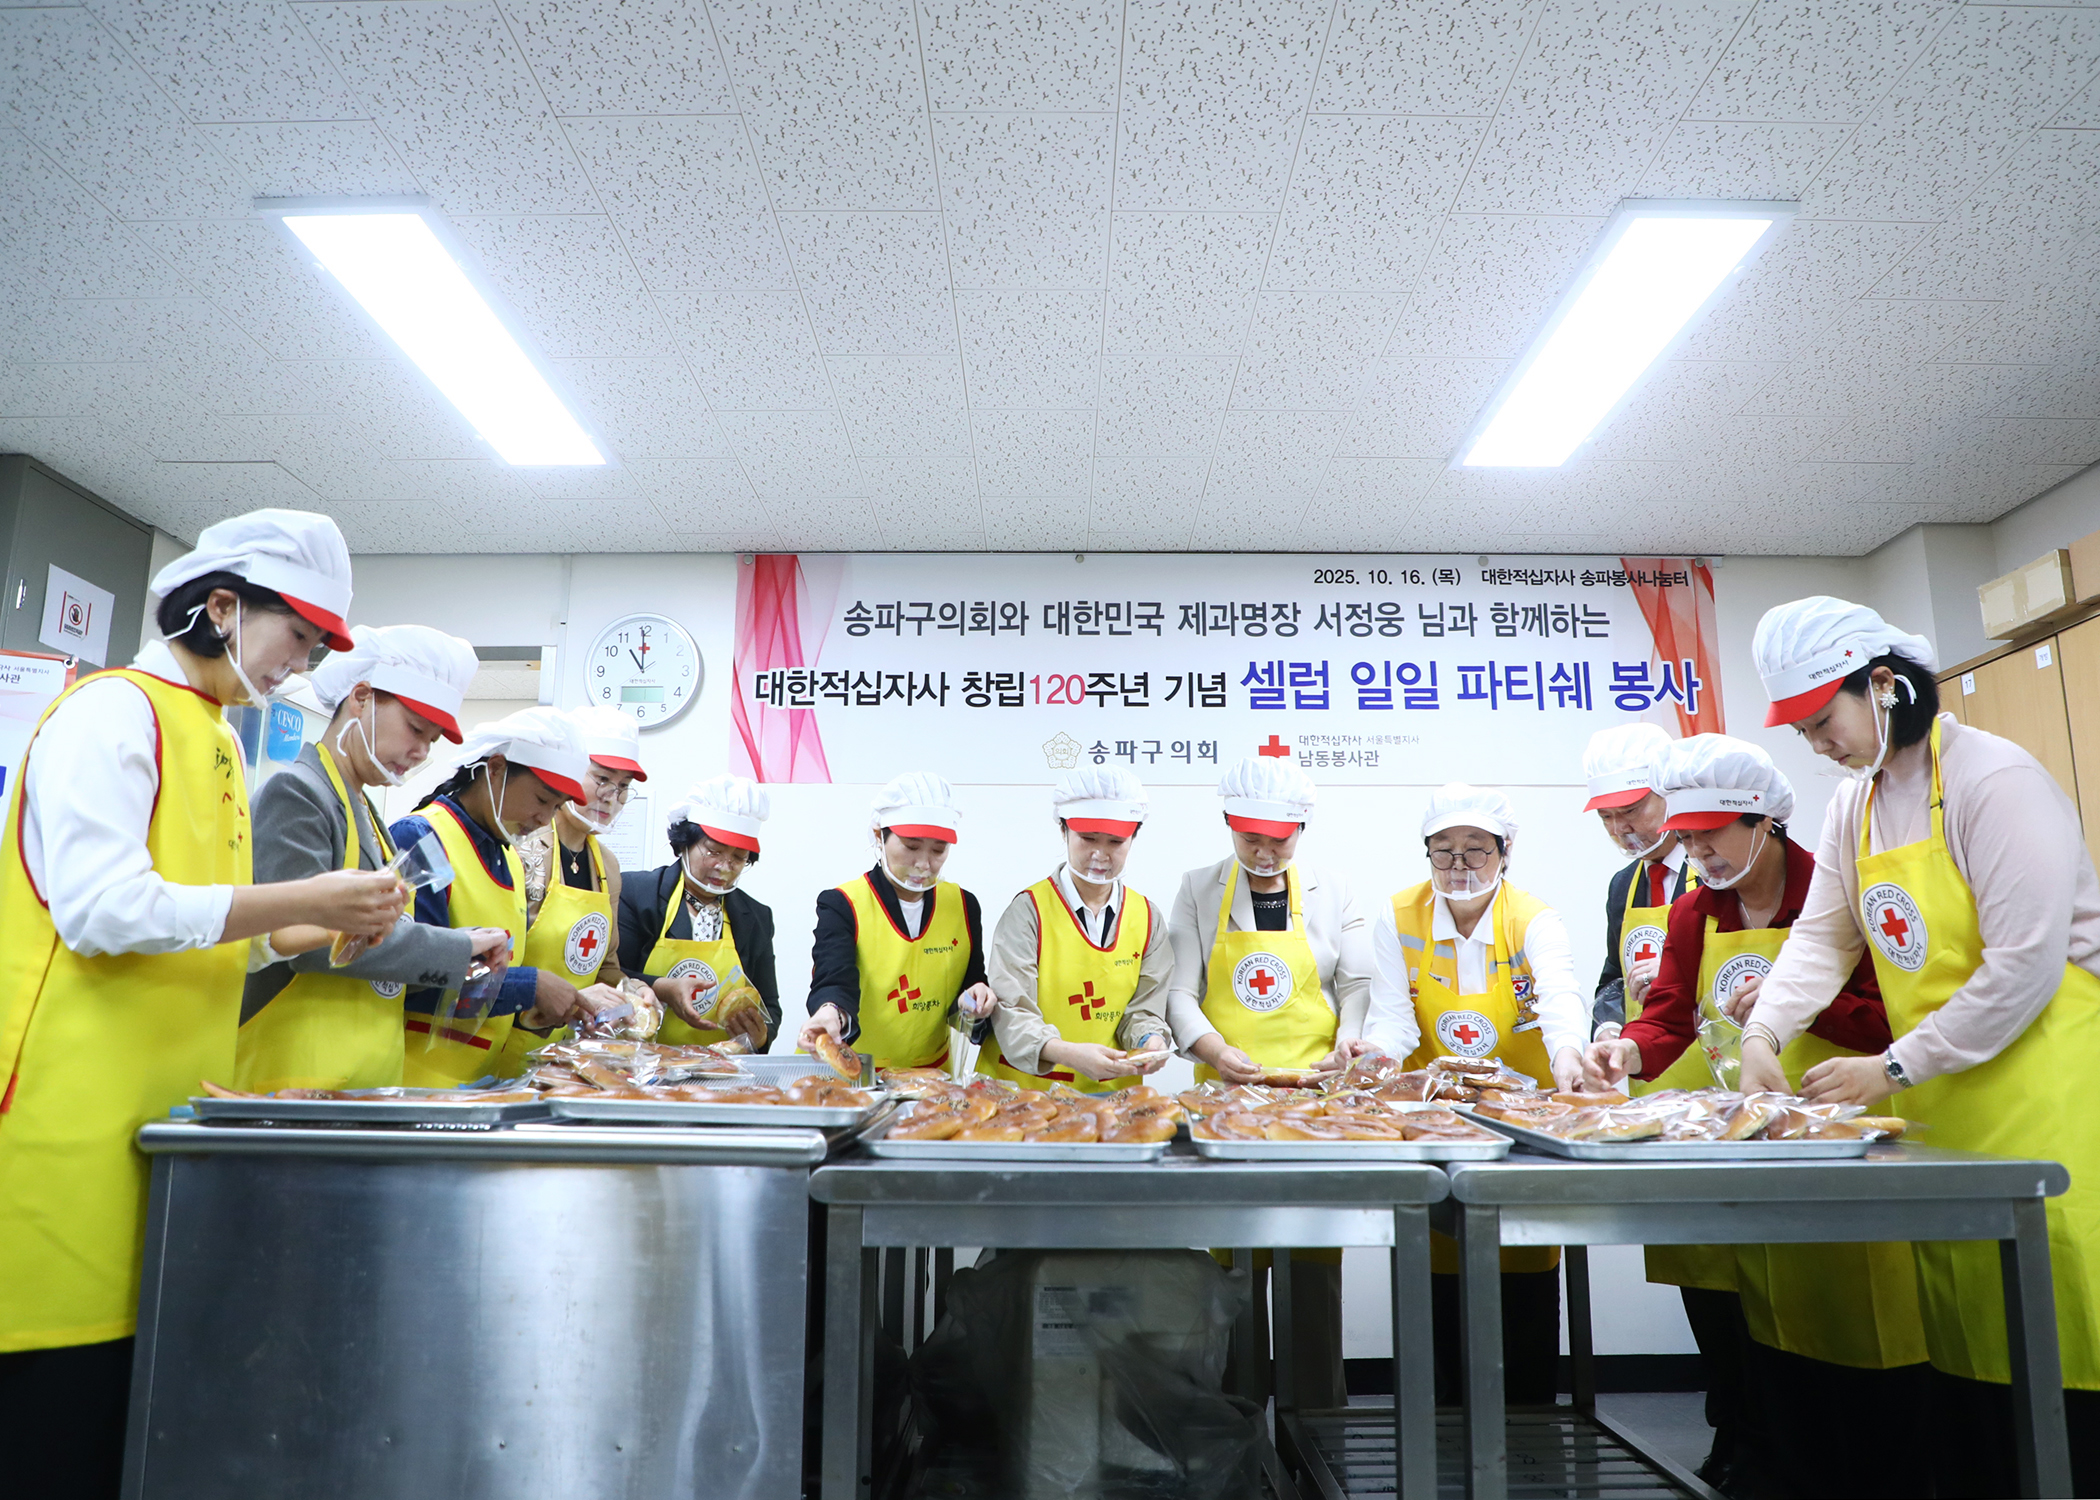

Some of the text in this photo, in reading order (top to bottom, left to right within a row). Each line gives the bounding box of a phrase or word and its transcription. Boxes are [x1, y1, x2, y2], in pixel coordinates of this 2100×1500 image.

[1313, 567, 1690, 588] 2025. 10. 16. (목) 대한적십자사 송파봉사나눔터
[843, 600, 1611, 639] 송파구의회와 대한민국 제과명장 서정웅 님과 함께하는
[618, 632, 629, 643] 11
[639, 625, 652, 637] 12
[664, 632, 669, 643] 1
[605, 645, 618, 657] 10
[676, 645, 684, 656] 2
[596, 665, 605, 677] 9
[681, 665, 690, 677] 3
[1808, 659, 1850, 680] 대한적십자사
[754, 659, 1700, 712] 대한적십자사 창립120주년 기념 셀럽 일일 파티쉐 봉사
[1965, 679, 1972, 688] 17
[602, 686, 611, 699] 8
[673, 686, 682, 697] 4
[637, 705, 645, 718] 6
[660, 703, 667, 712] 5
[277, 709, 302, 733] CESCO
[1298, 734, 1420, 746] 대한적십자사 서울특별지사
[1087, 740, 1218, 765] 송파구의회
[1298, 750, 1380, 767] 남동봉사관
[1719, 799, 1753, 807] 대한적십자사
[1866, 889, 1919, 932] KOREAN RED CROSS
[571, 918, 591, 942] KOREAN
[1626, 931, 1643, 957] KOREAN
[1644, 930, 1658, 938] RED
[1887, 942, 1923, 966] 대한적십자사
[688, 962, 701, 970] RED
[1237, 956, 1287, 985] KOREAN RED CROSS
[1719, 960, 1743, 993] KOREAN
[1744, 959, 1762, 969] RED
[1245, 992, 1284, 1008] 대한적십자사
[1440, 1014, 1457, 1032] KOREAN
[1473, 1015, 1493, 1035] CROSS
